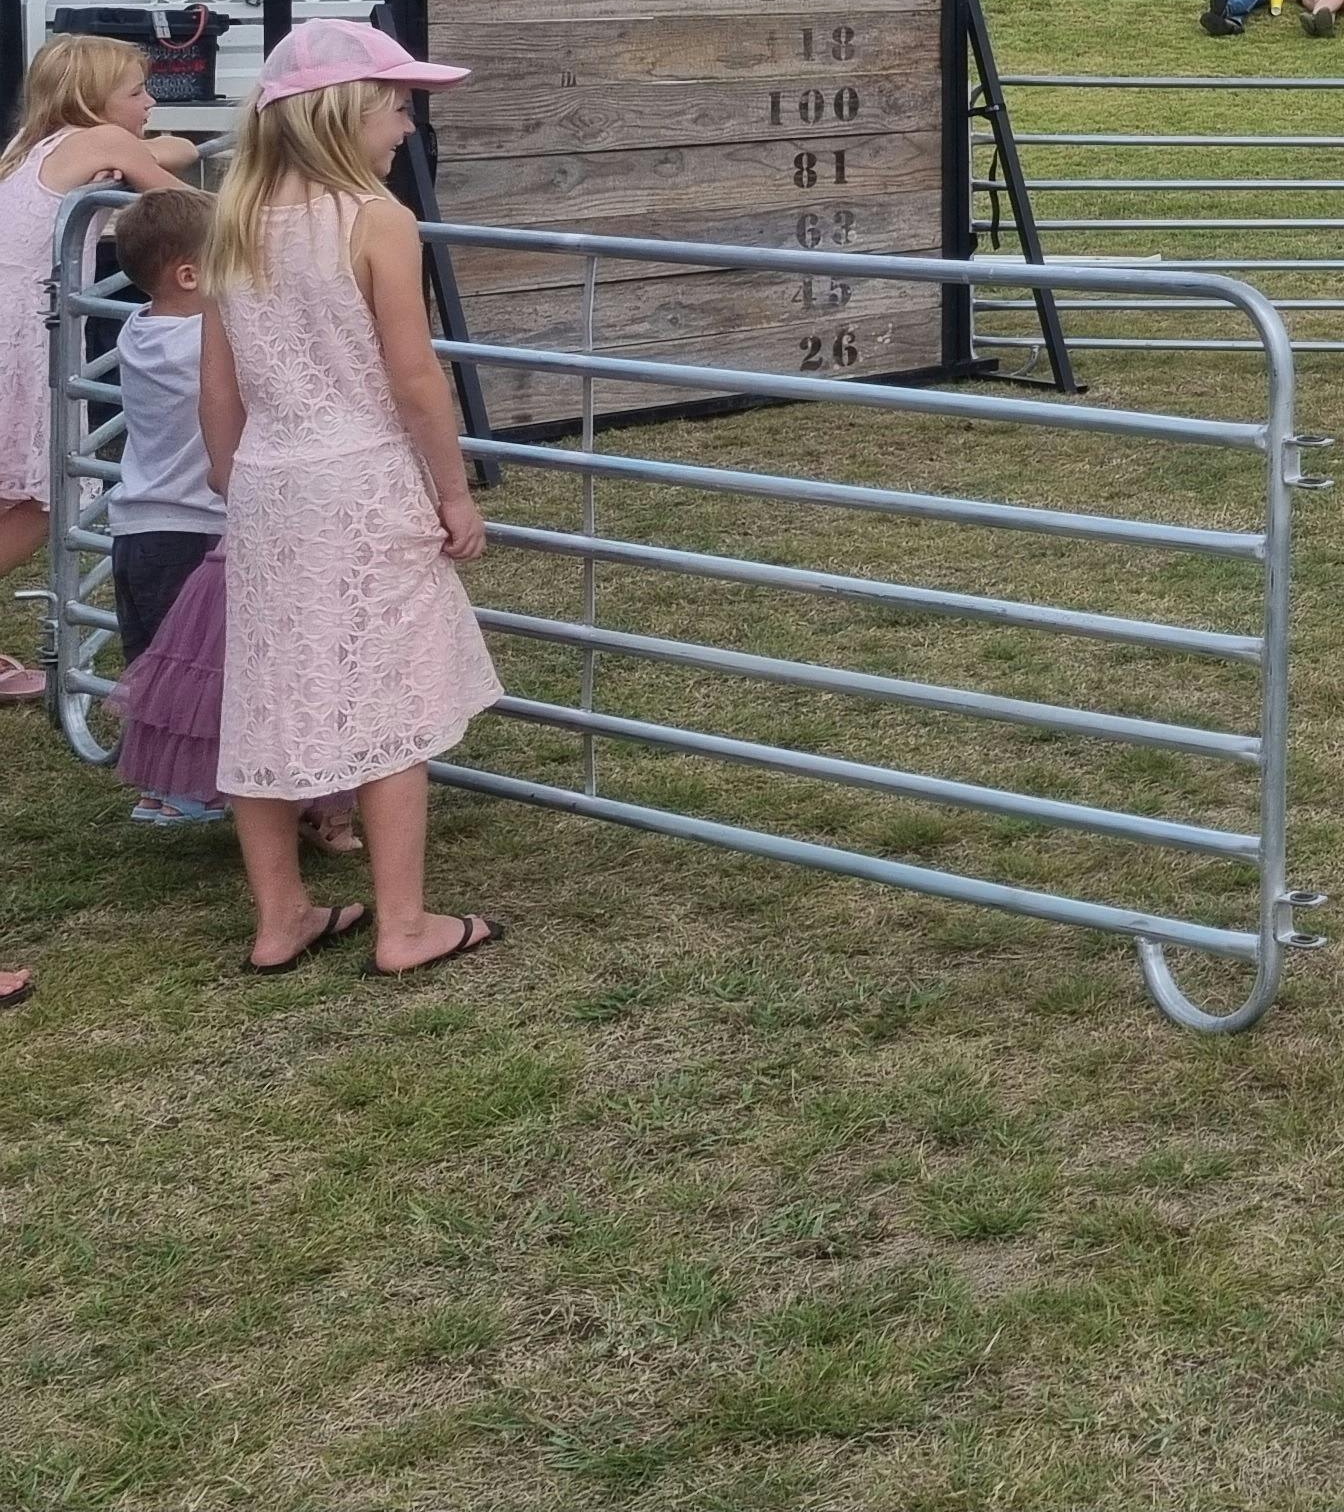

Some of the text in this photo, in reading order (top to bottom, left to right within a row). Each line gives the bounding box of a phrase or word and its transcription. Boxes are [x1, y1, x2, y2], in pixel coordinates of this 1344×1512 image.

[769, 88, 860, 126] 100
[793, 150, 848, 189] 81
[796, 210, 855, 248] 63
[800, 330, 858, 371] 26
